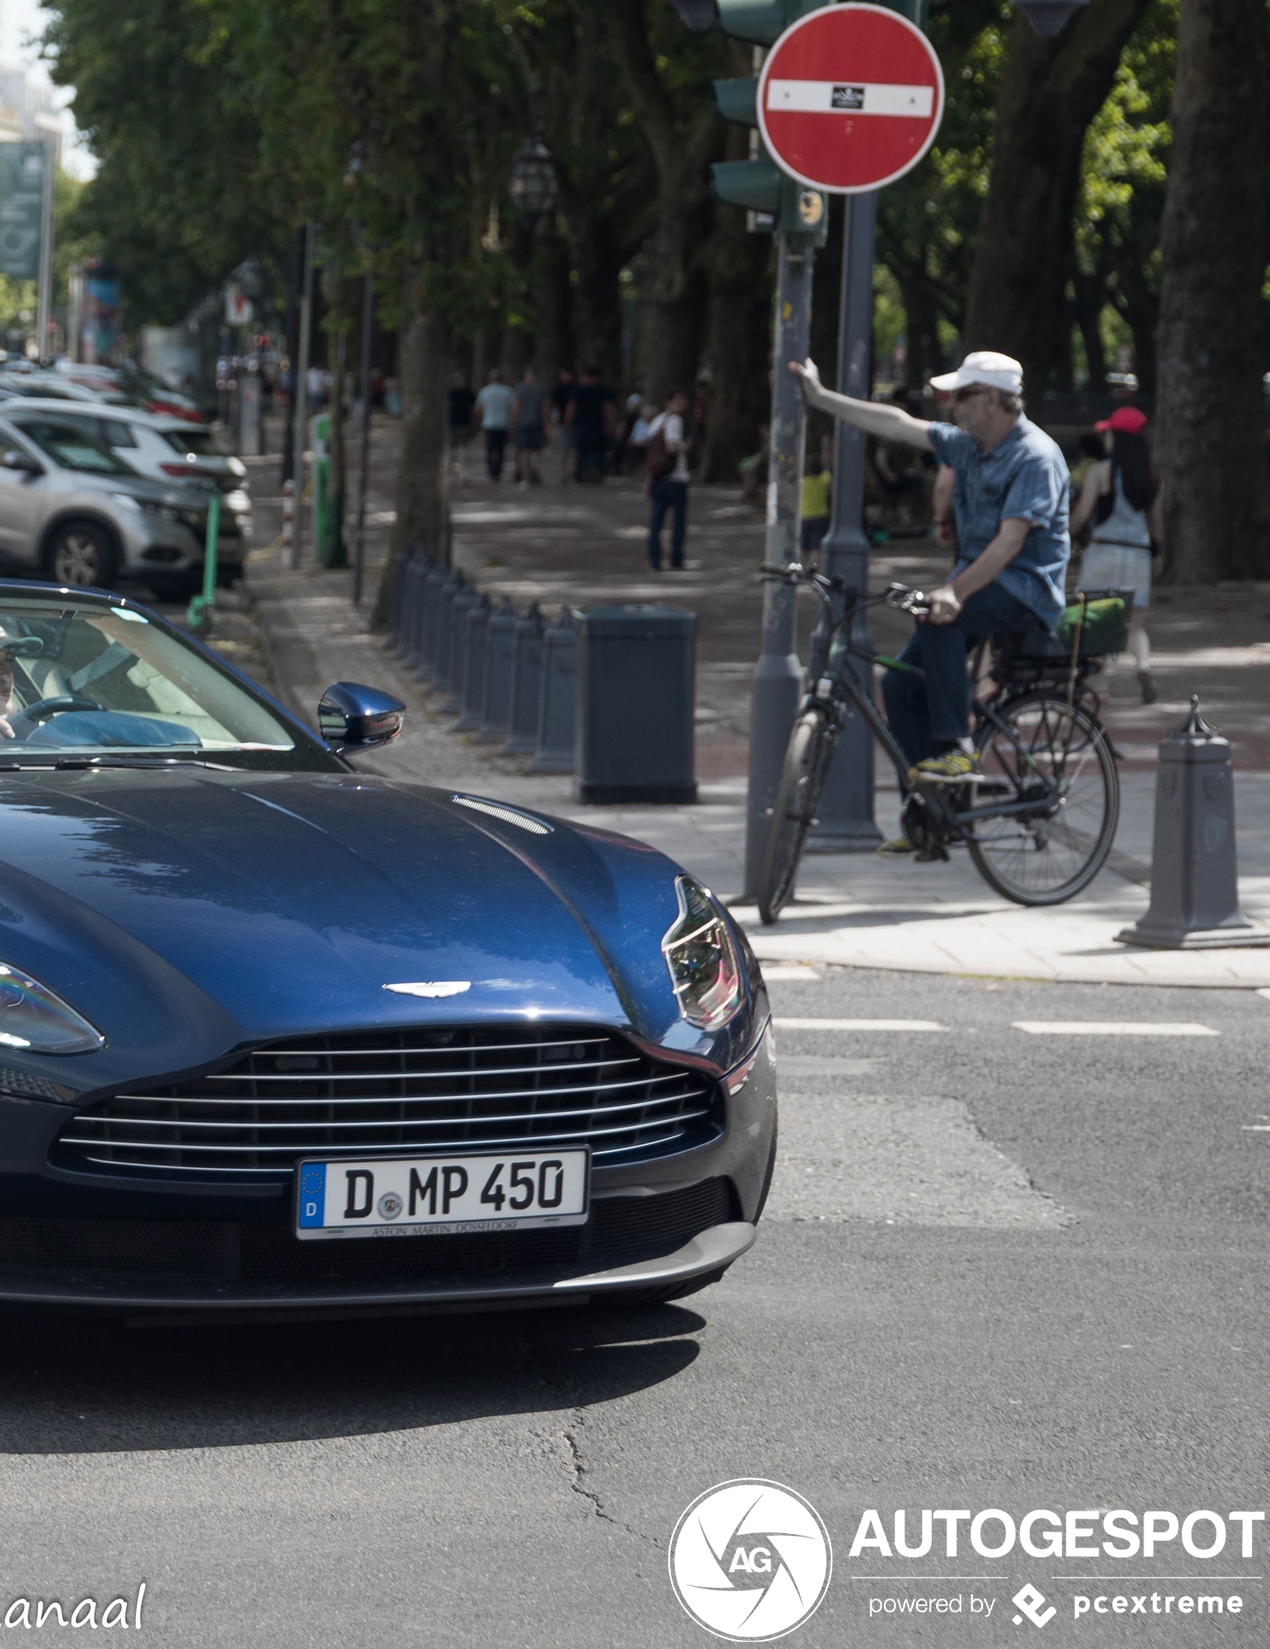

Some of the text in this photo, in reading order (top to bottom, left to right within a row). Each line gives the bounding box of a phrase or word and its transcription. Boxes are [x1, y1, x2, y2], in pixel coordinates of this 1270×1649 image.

[343, 1159, 564, 1219] D MP 450
[305, 1202, 317, 1217] D
[371, 1226, 408, 1238] ASTON
[412, 1223, 451, 1236] MARTIN
